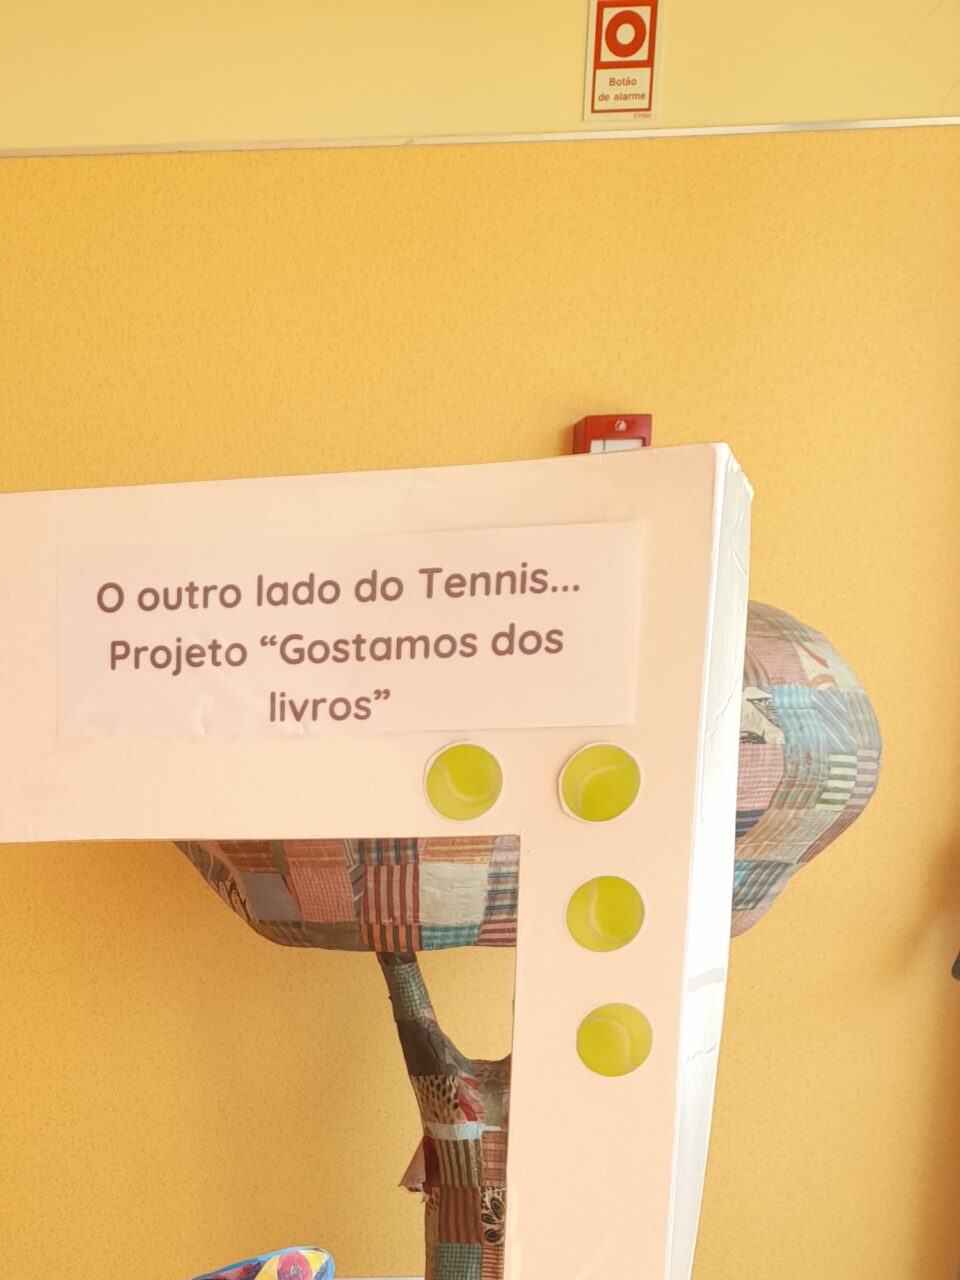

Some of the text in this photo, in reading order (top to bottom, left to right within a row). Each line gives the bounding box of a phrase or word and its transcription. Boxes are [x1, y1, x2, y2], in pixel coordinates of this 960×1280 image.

[598, 92, 646, 101] de alarme
[609, 77, 637, 86] Botão
[96, 561, 580, 613] O outro lado do Tennis...
[110, 623, 564, 676] Projeto “Gostamos dos
[269, 688, 391, 722] livros”
